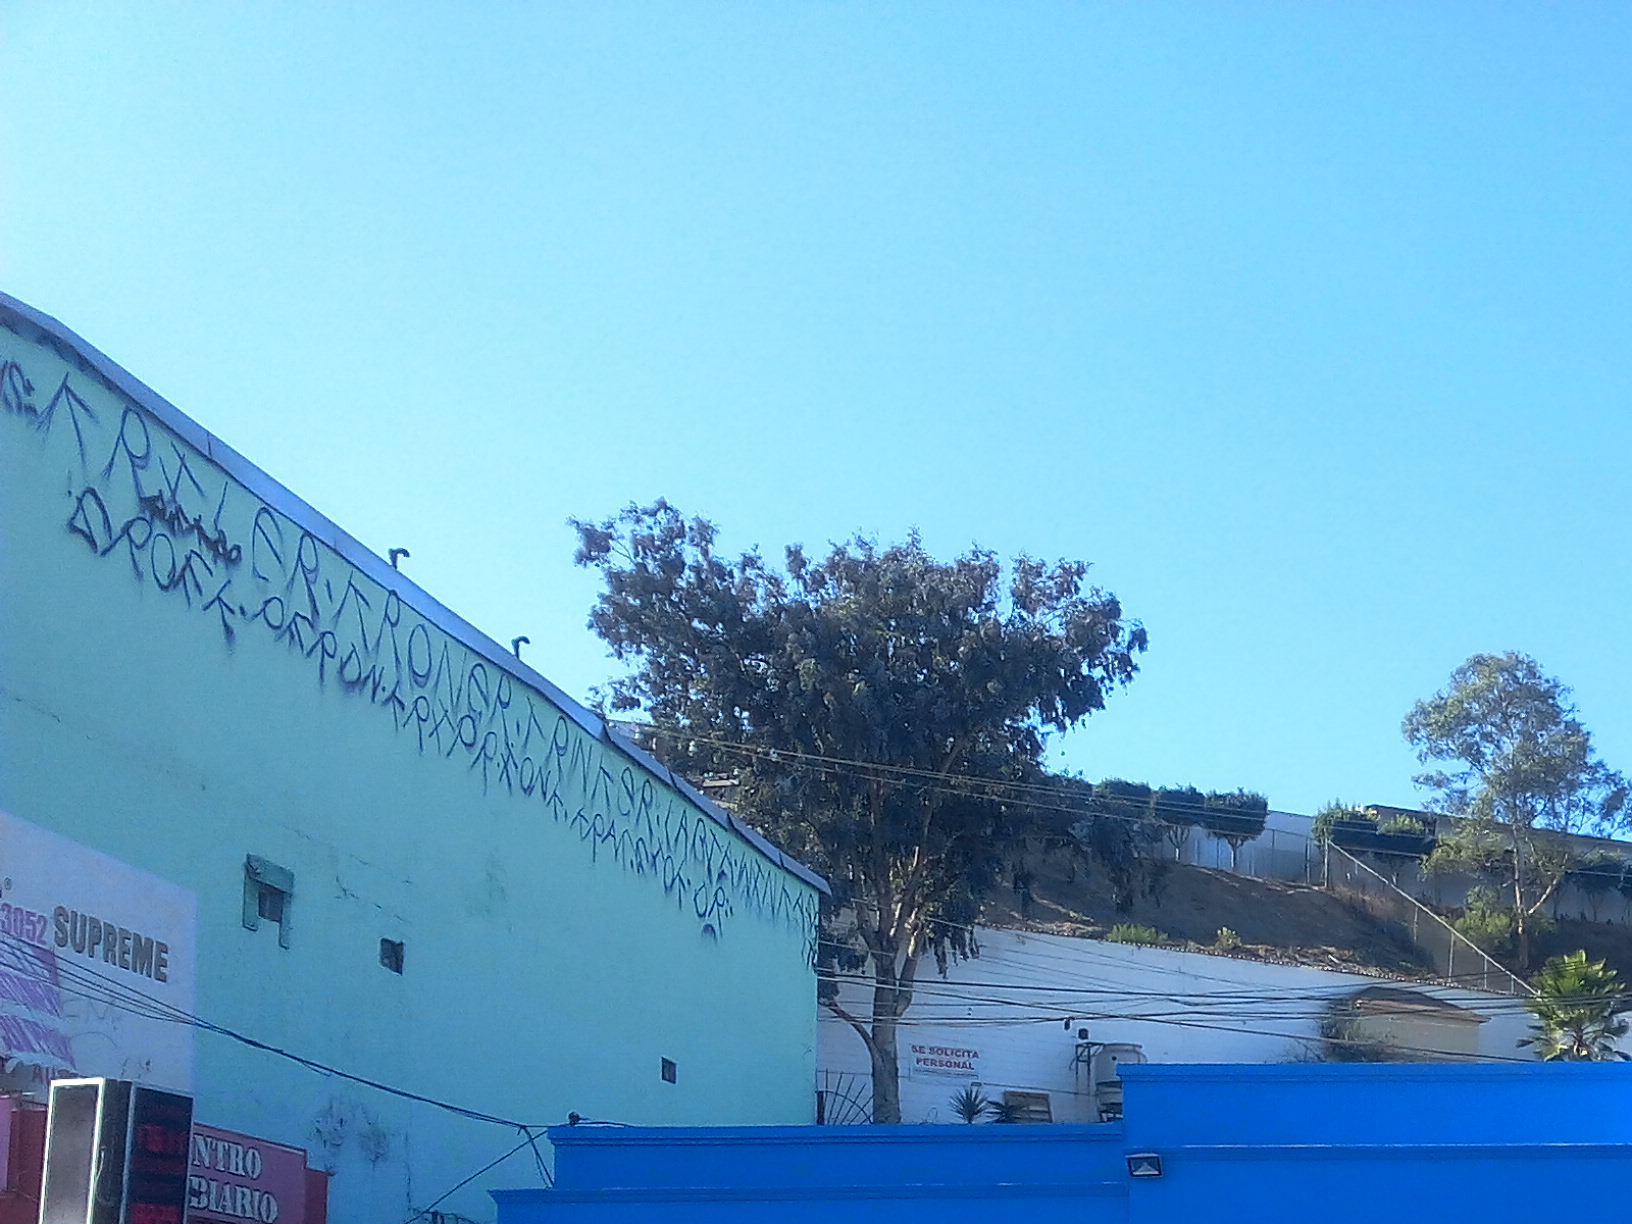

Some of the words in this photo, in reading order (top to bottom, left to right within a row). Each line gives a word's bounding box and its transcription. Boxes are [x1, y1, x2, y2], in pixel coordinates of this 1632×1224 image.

[54, 905, 168, 983] SUPREME
[916, 1058, 974, 1070] PERSONAL
[929, 1047, 979, 1058] SOLICITA
[193, 1134, 262, 1180] NTRO
[189, 1175, 279, 1224] BIARIO
